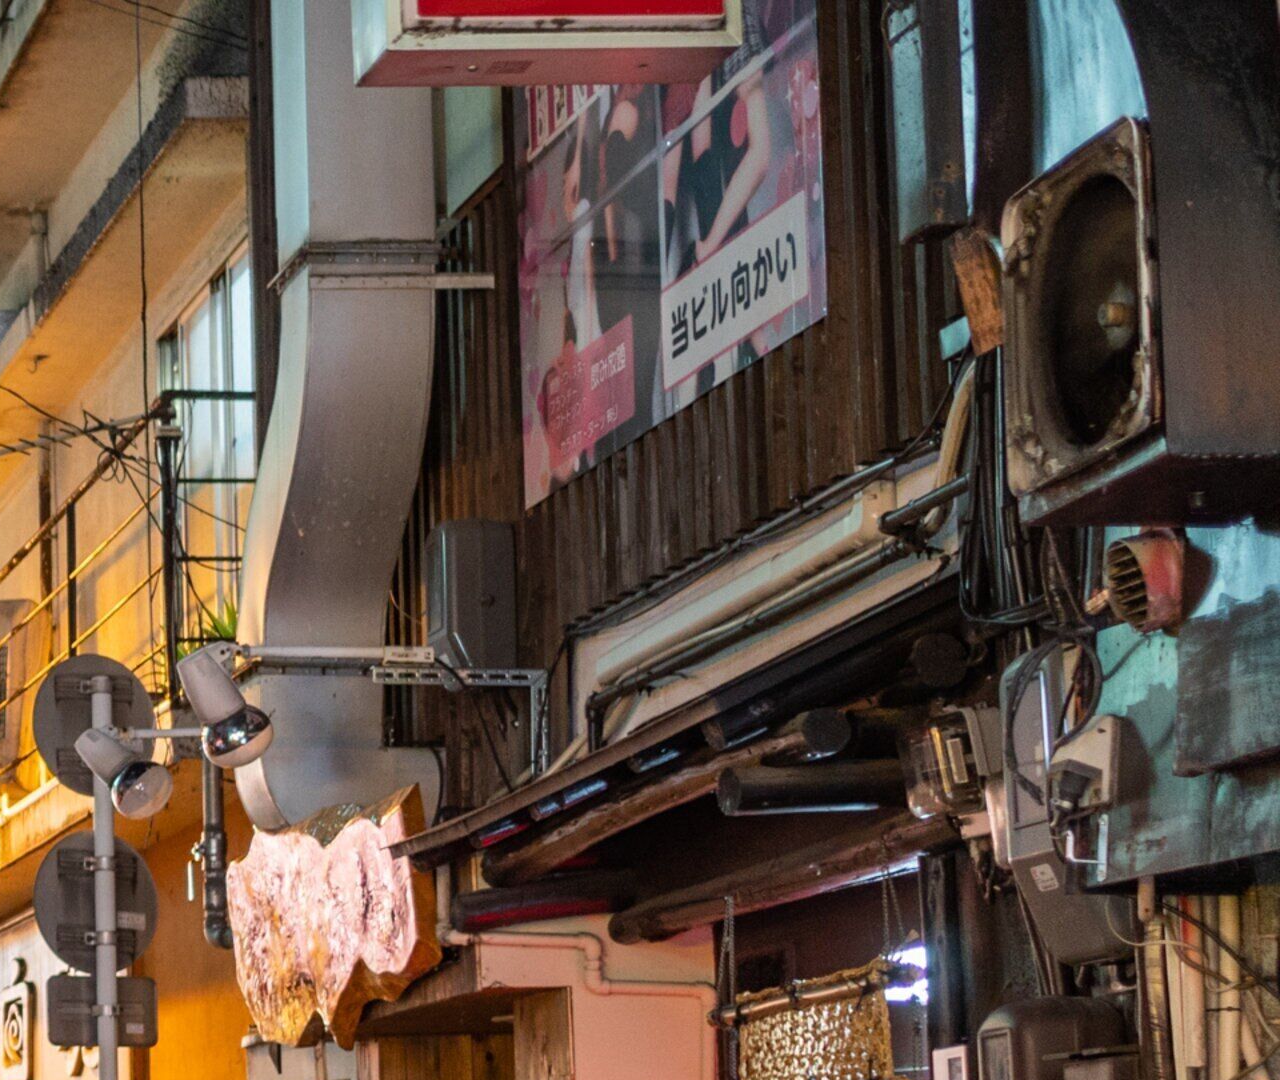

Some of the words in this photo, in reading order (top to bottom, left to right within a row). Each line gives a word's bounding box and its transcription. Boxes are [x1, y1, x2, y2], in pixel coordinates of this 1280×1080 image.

[670, 231, 798, 359] 当ビル向かい
